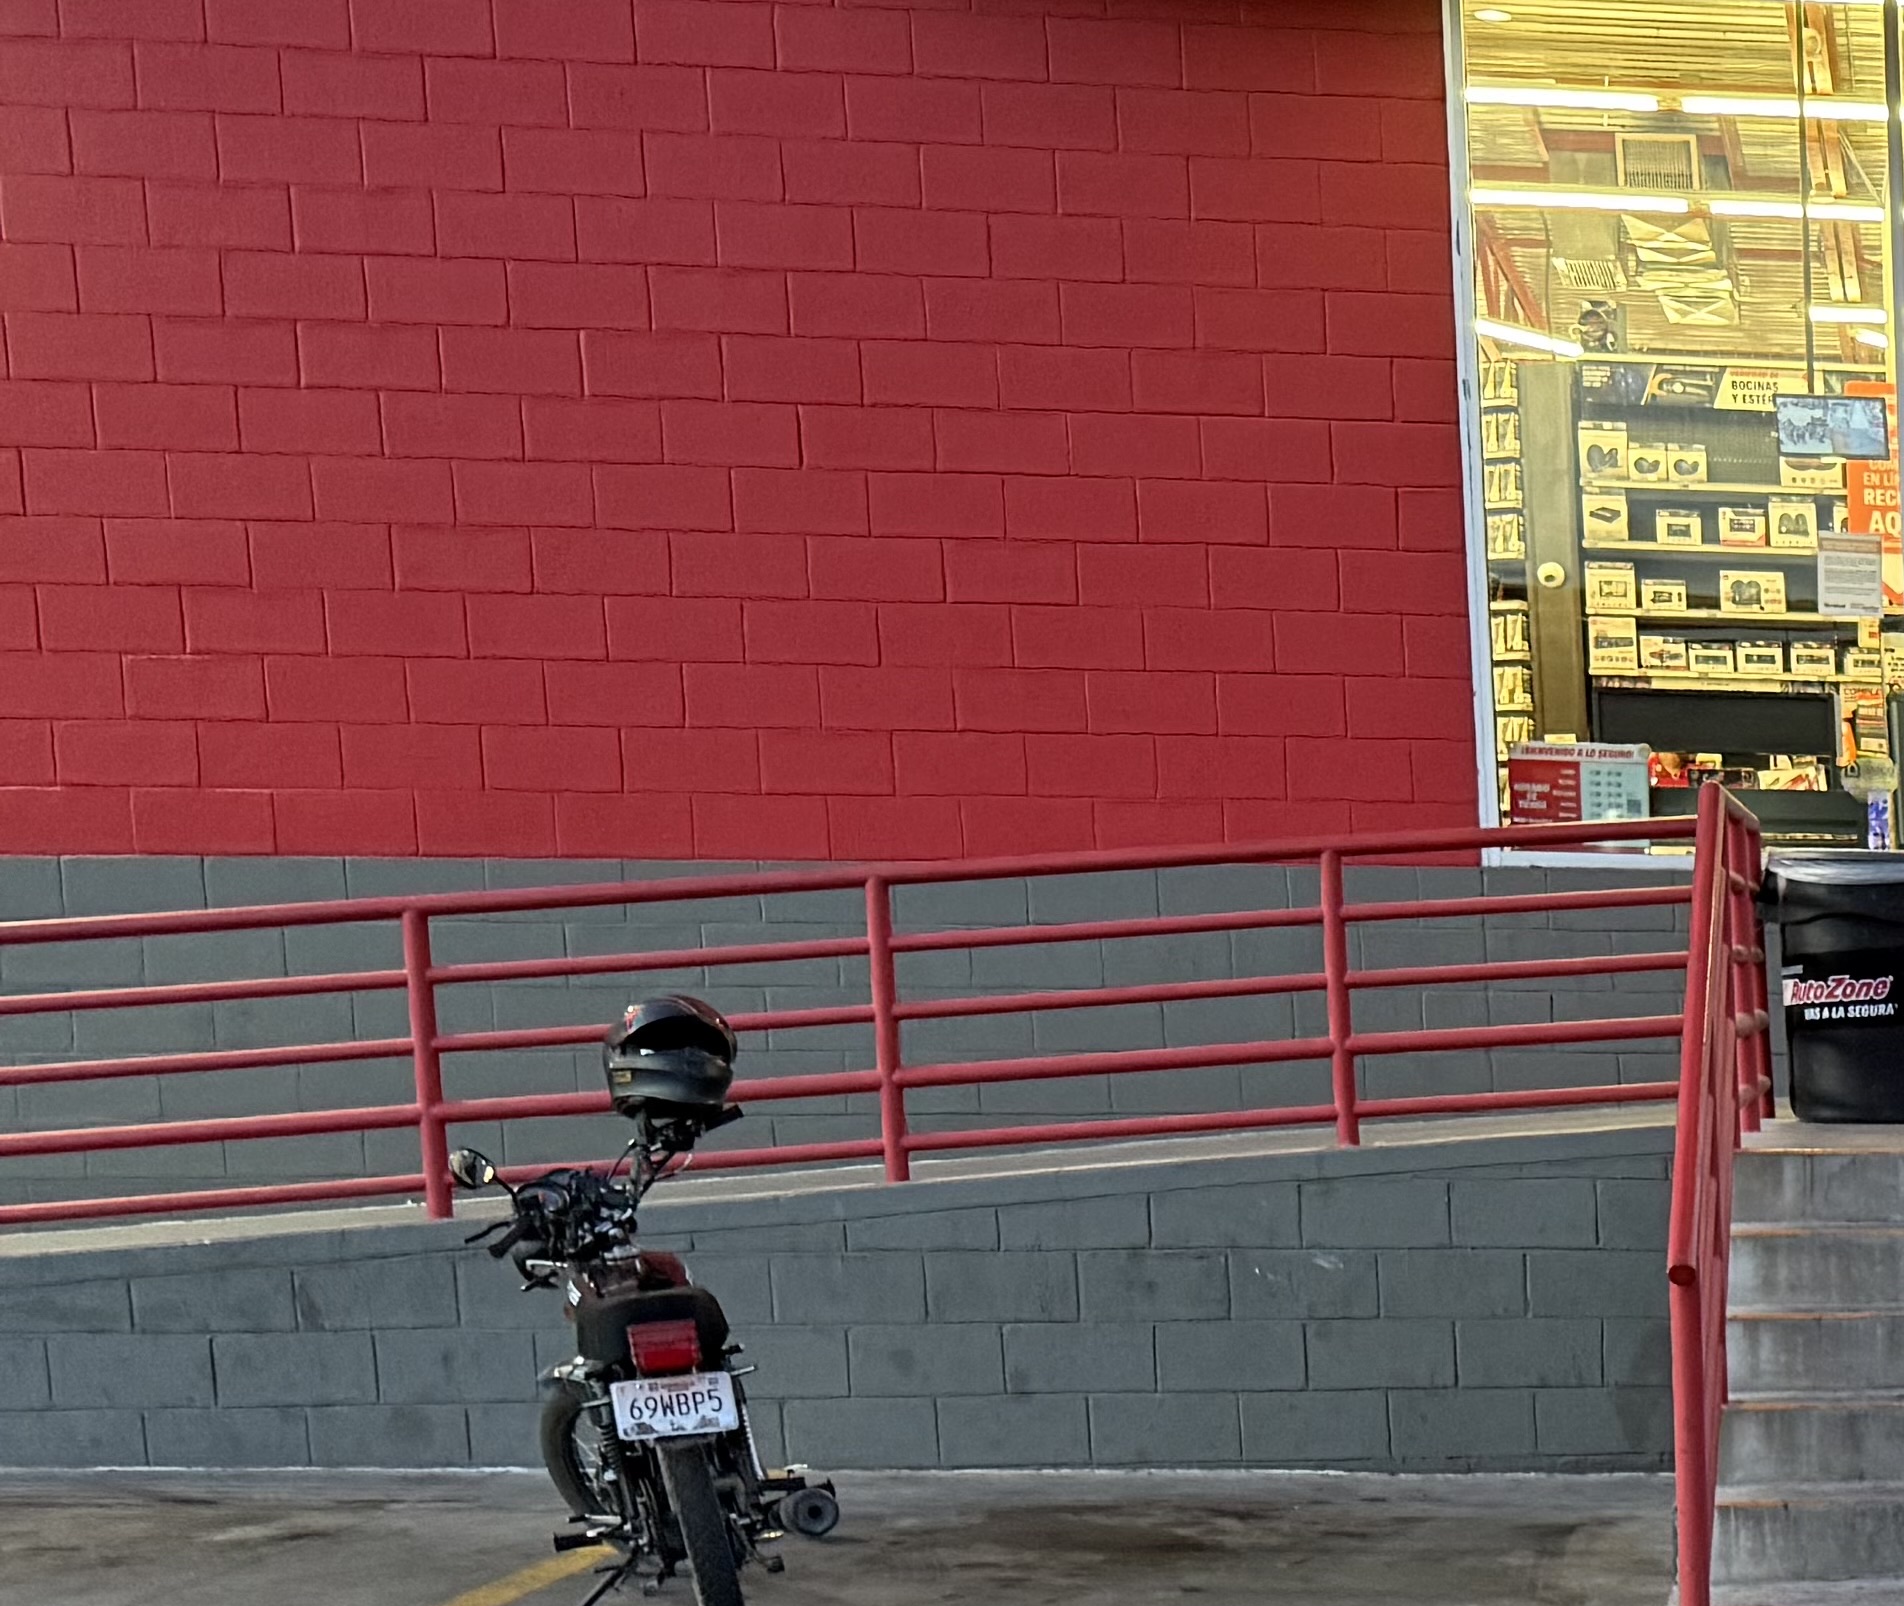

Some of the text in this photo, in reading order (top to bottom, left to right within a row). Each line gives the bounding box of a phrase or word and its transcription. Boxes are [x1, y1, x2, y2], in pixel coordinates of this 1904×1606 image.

[1731, 380, 1779, 393] BOCINAS
[1732, 393, 1738, 404] Y
[1863, 472, 1880, 486] EN
[1791, 975, 1891, 1004] AutoZone
[1822, 1006, 1829, 1019] A
[1831, 1006, 1845, 1018] LA
[1847, 1003, 1894, 1018] SEGURA
[630, 1388, 723, 1420] 69WBP5
